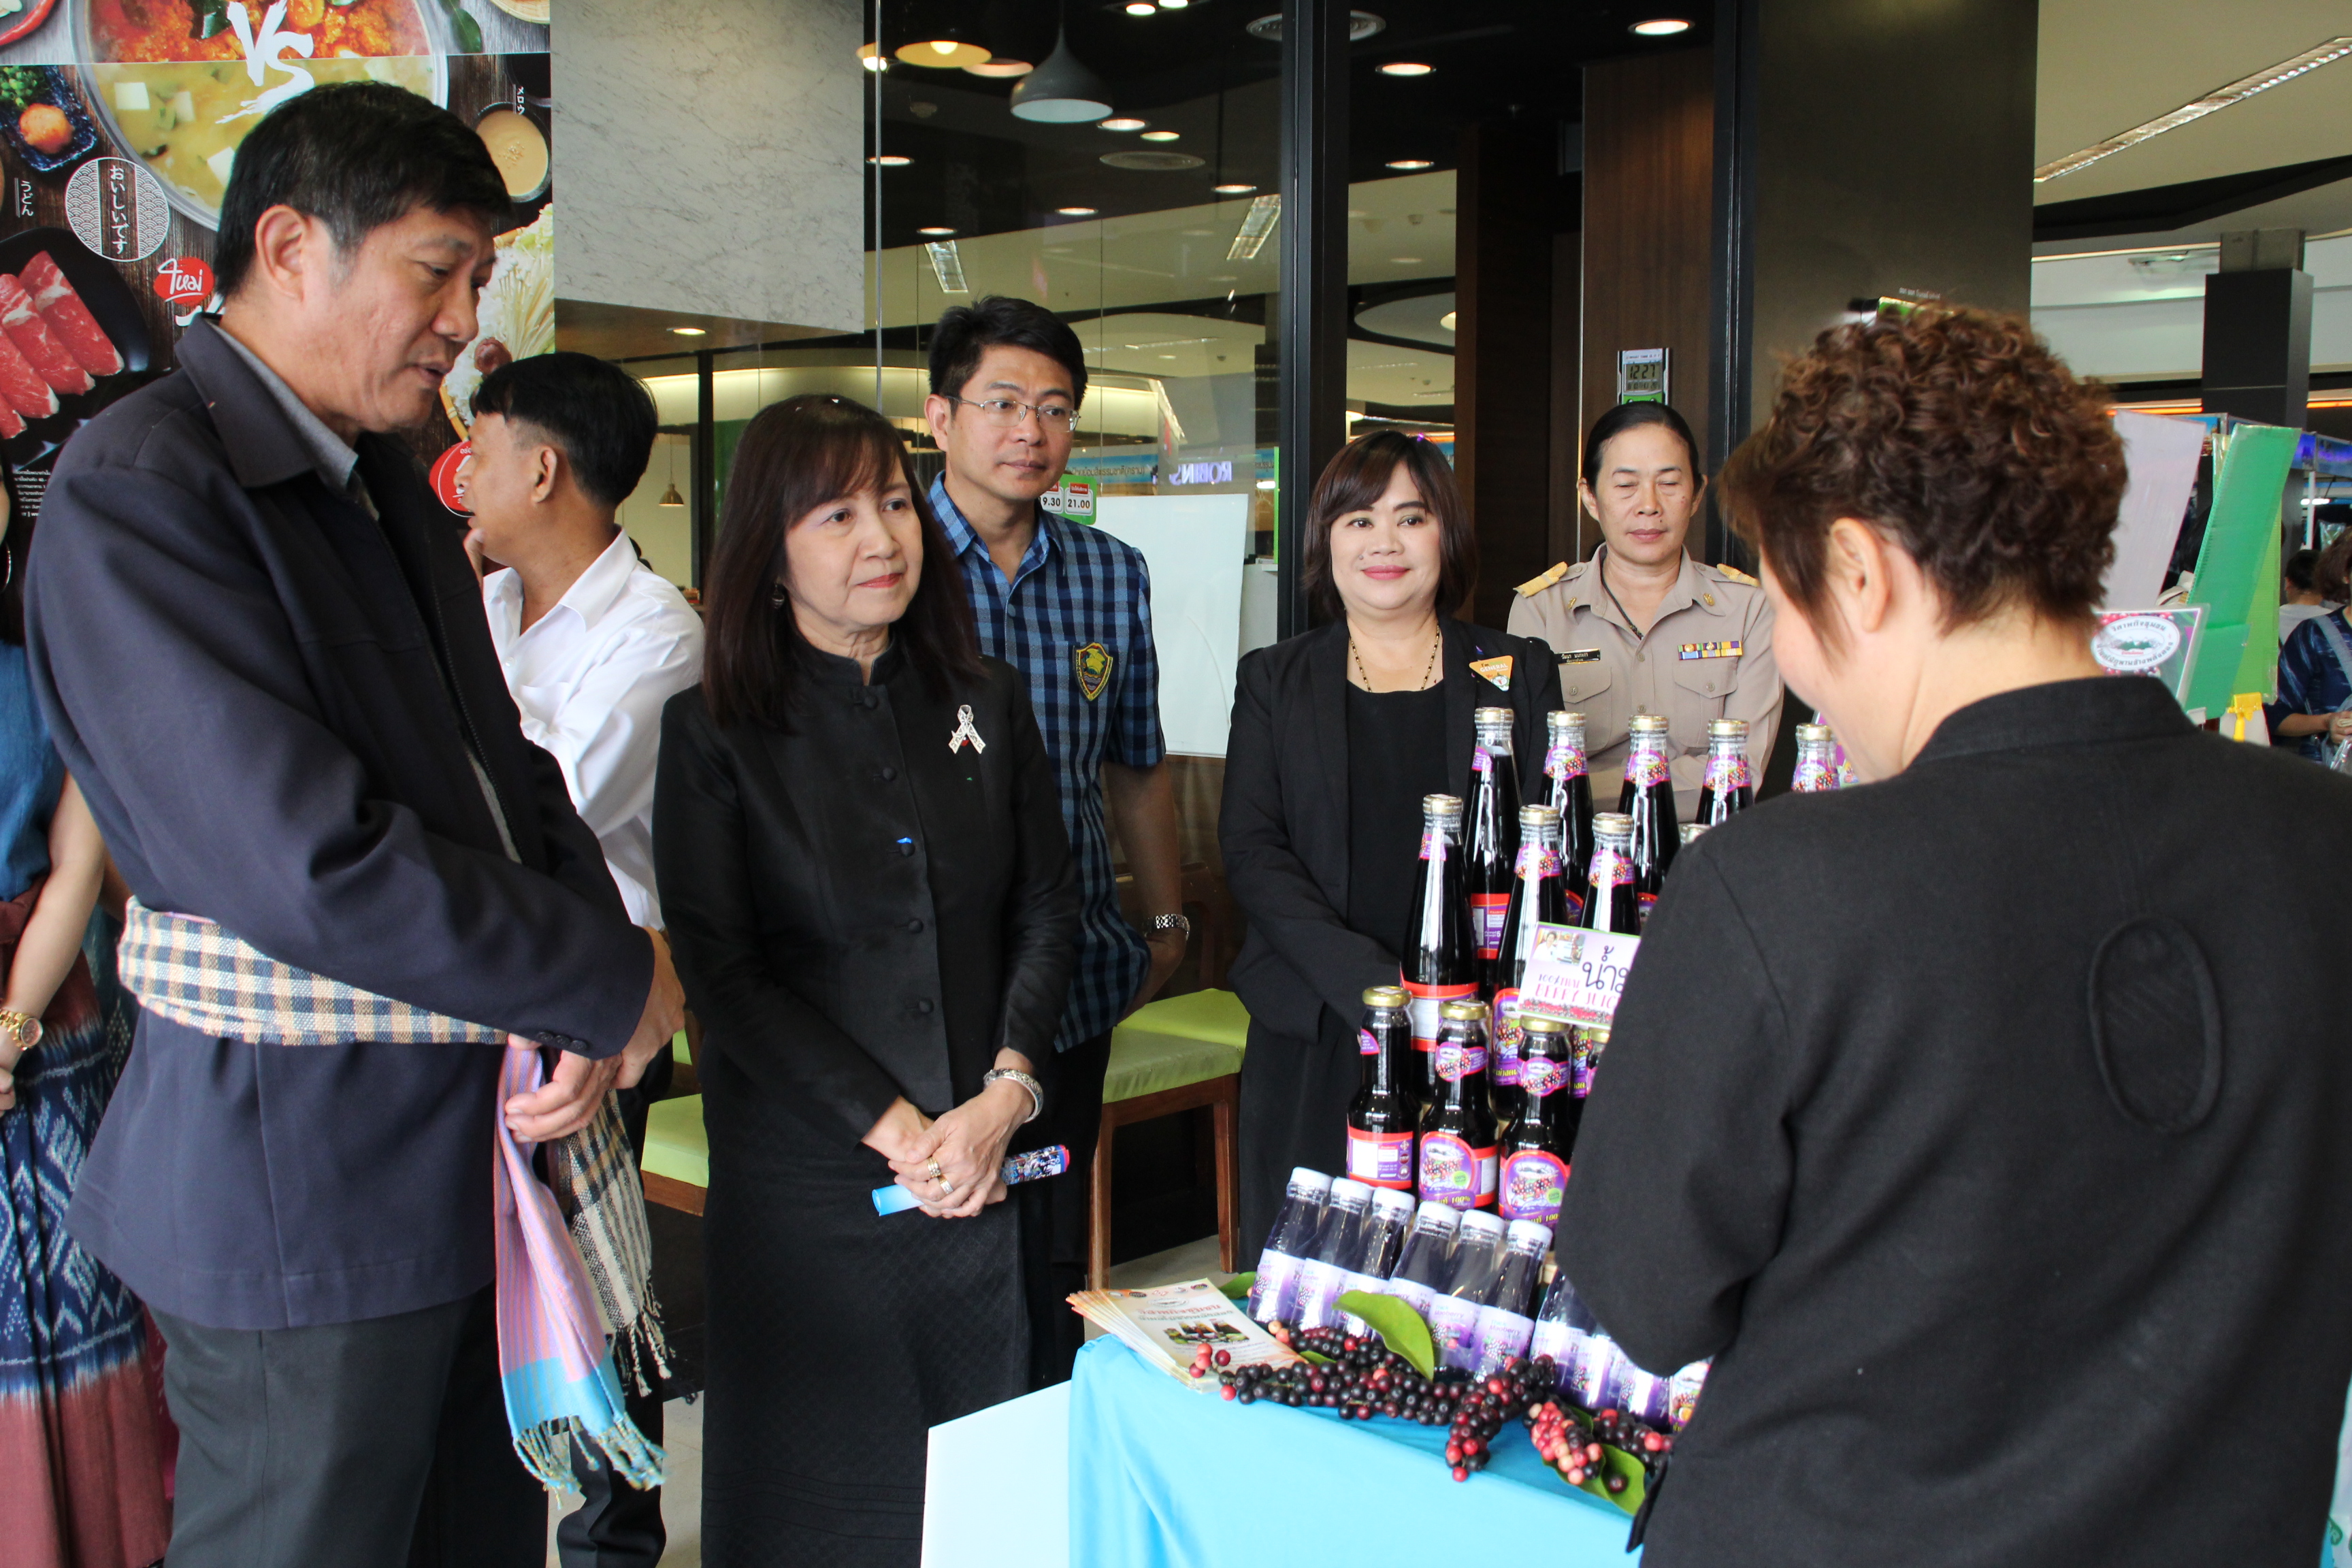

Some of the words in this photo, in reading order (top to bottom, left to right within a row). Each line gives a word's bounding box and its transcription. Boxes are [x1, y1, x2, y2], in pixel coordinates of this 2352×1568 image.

[215, 0, 315, 125] VS
[21, 180, 33, 216] うどん
[110, 165, 127, 255] おいしいです
[1068, 499, 1090, 509] 21.00
[1480, 663, 1509, 672] GENERAL
[1535, 983, 1580, 1003] BERRY
[1584, 992, 1621, 1009] JUIC
[1545, 1213, 1559, 1222] 100
